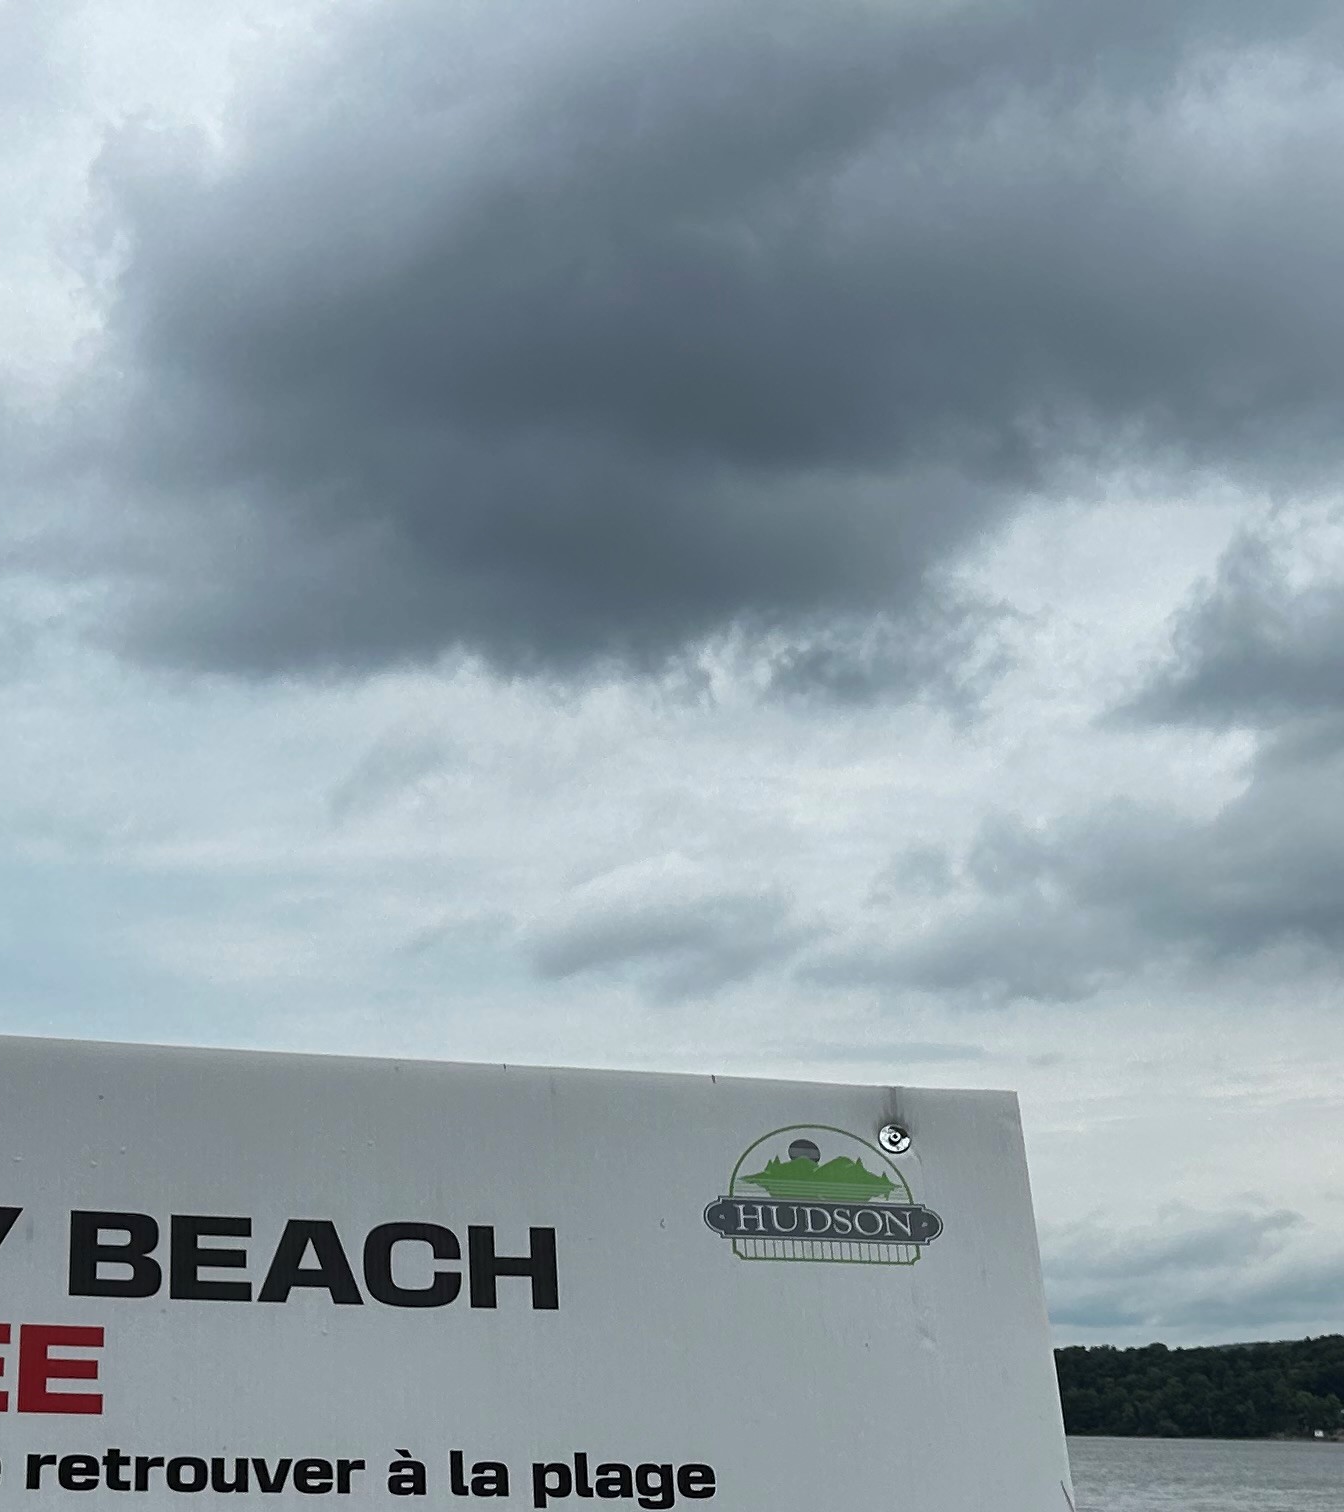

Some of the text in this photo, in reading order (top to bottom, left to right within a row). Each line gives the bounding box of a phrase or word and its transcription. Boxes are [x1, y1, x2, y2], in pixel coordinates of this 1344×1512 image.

[735, 1204, 913, 1236] HUDSON
[69, 1210, 559, 1310] BEACH
[26, 1449, 365, 1494] retrouver
[388, 1449, 426, 1495] à
[450, 1450, 509, 1497] la
[533, 1452, 715, 1509] plage
